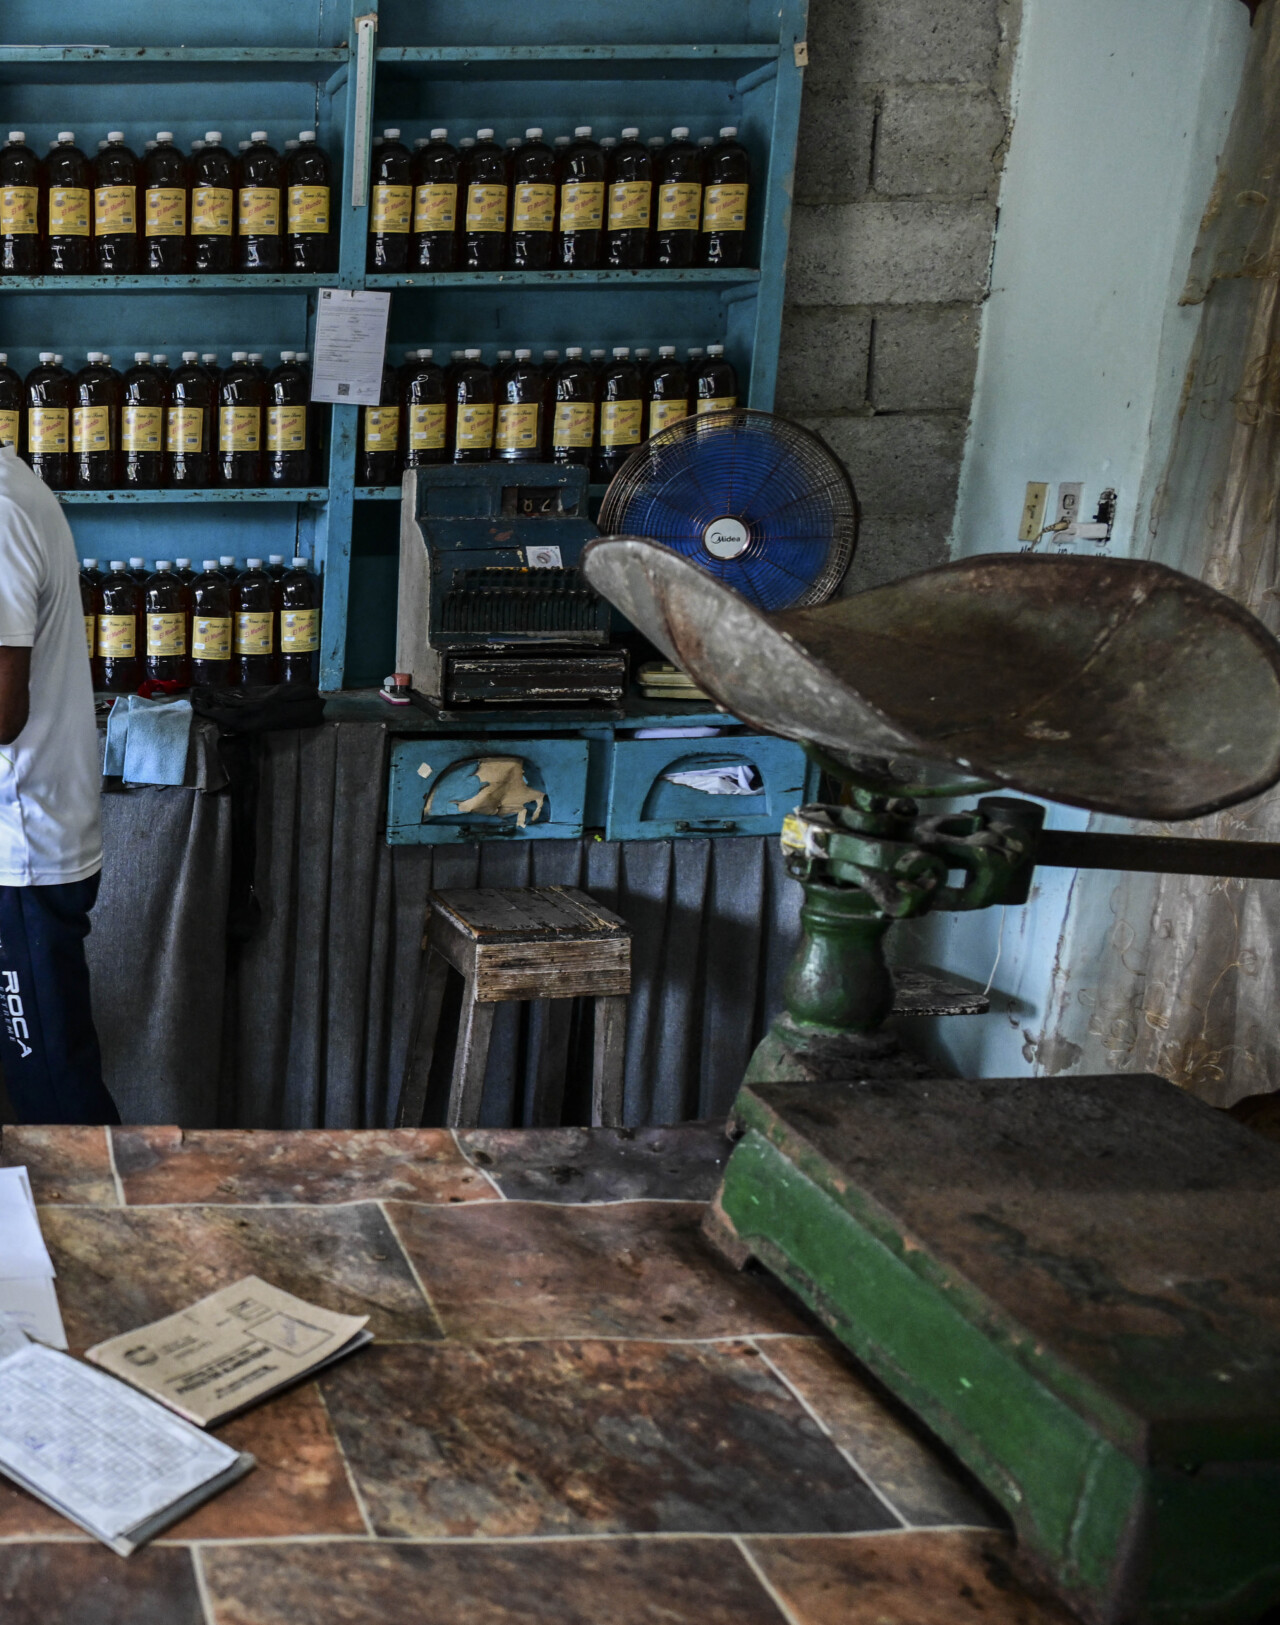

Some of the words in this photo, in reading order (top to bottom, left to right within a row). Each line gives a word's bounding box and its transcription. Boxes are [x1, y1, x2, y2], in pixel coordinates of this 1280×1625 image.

[104, 206, 110, 215] El
[157, 208, 163, 217] El
[248, 208, 254, 217] El
[299, 206, 305, 215] El
[716, 535, 741, 543] Midea
[292, 627, 298, 636] El
[106, 632, 112, 641] El
[1, 970, 33, 1059] ROCA
